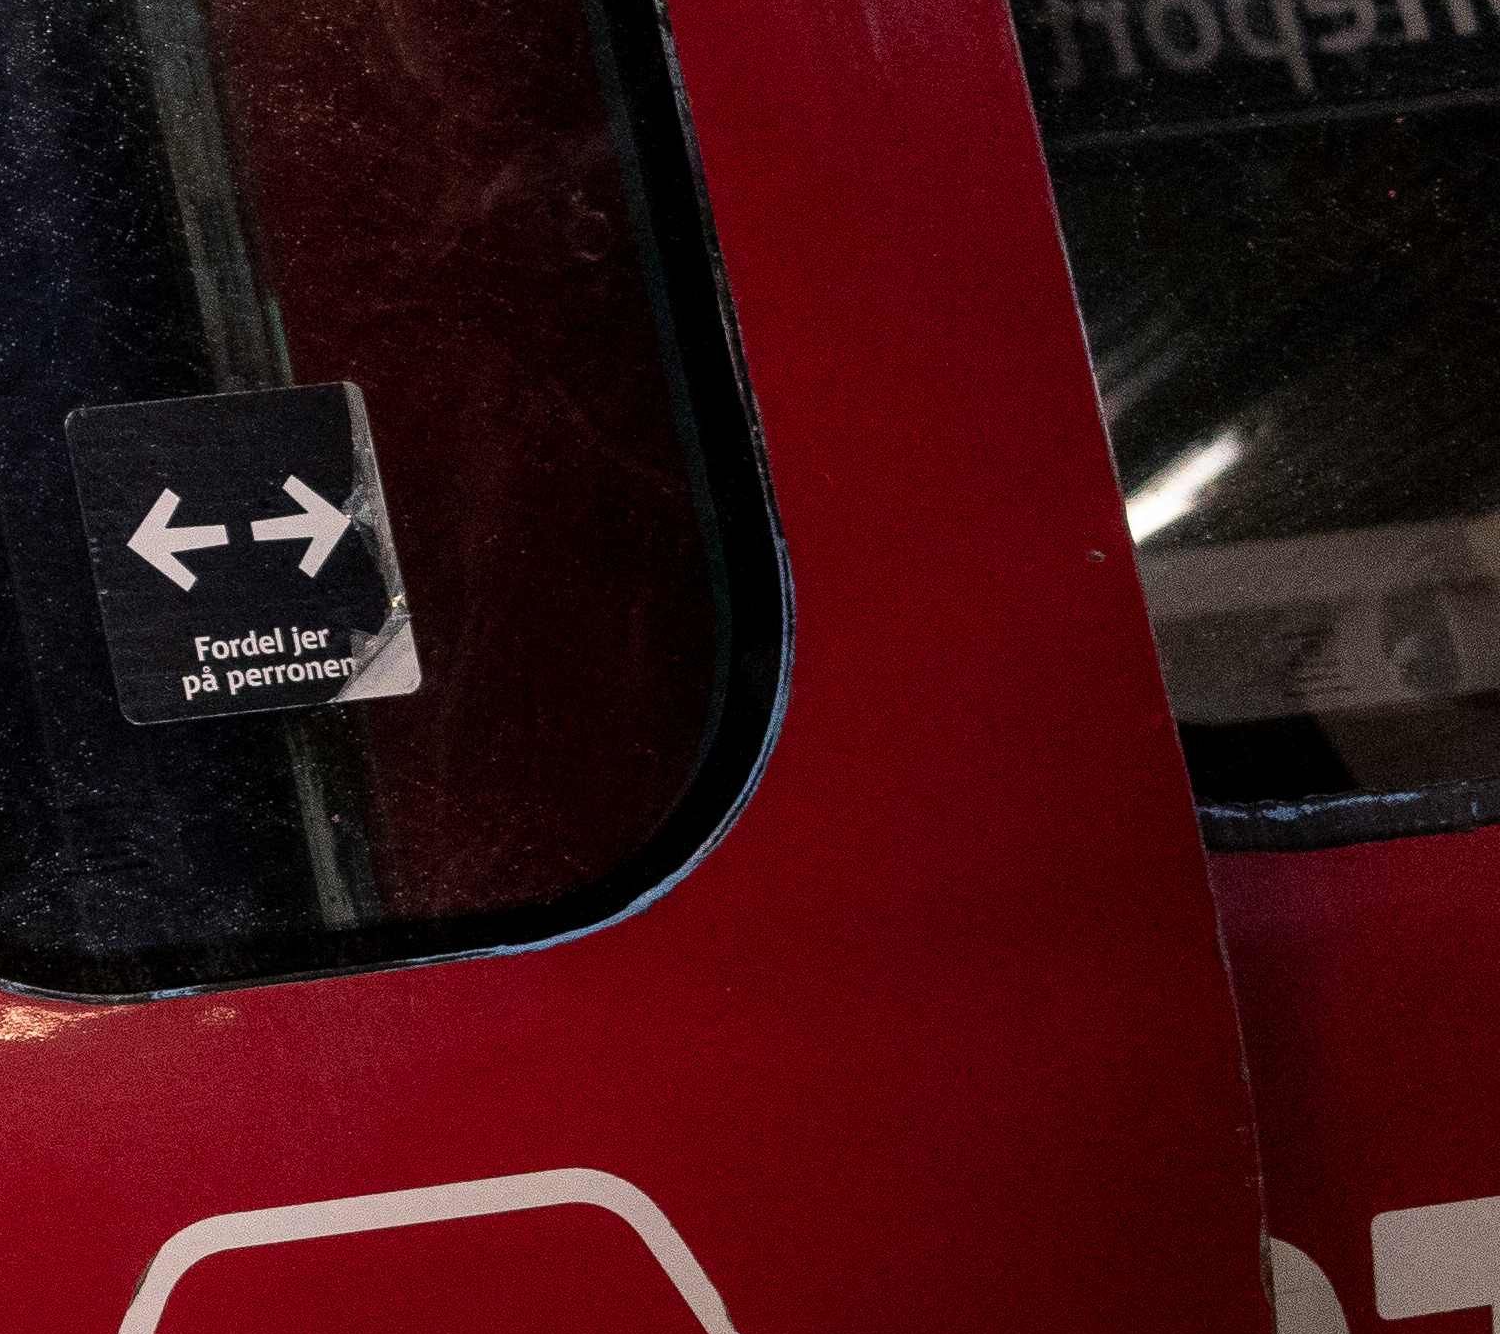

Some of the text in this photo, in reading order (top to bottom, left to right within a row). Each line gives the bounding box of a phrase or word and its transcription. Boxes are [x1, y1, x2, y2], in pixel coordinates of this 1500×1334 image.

[194, 626, 330, 661] Fordel jer
[181, 656, 355, 701] på perronen
